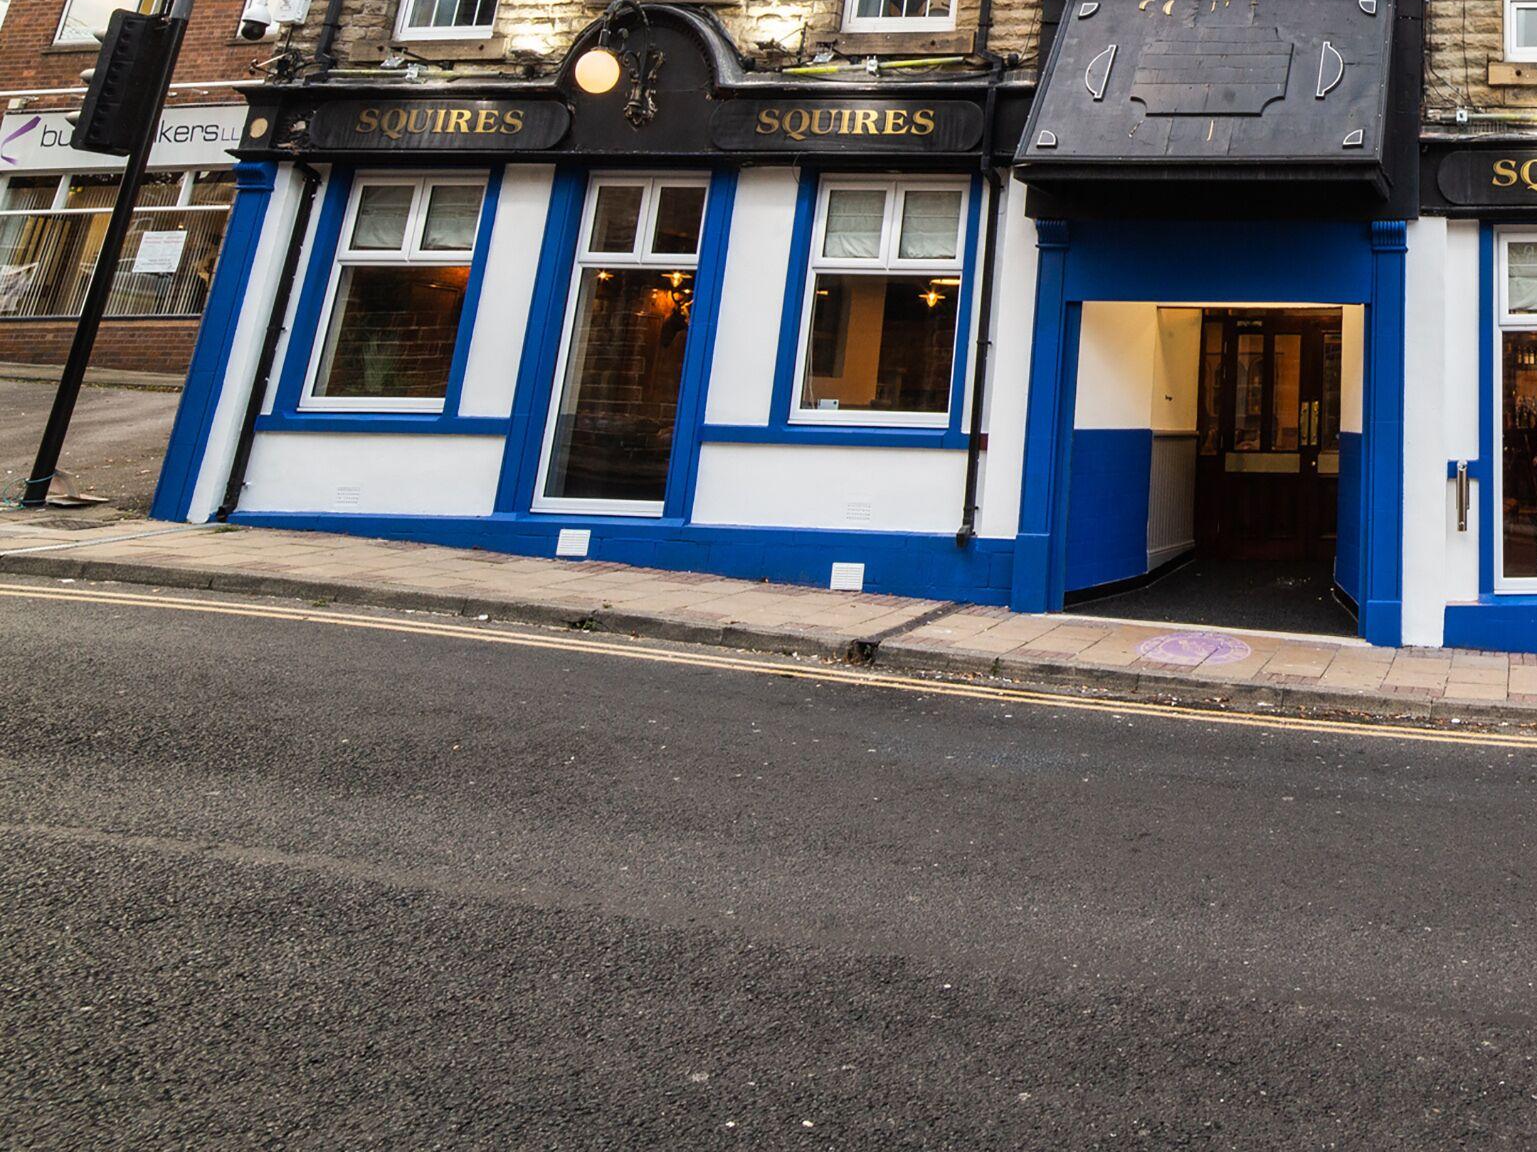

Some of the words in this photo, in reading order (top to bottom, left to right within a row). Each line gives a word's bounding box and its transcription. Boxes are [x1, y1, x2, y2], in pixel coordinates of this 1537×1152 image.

[221, 126, 241, 142] LL
[355, 107, 525, 140] SQUIRES
[755, 108, 936, 141] SQUIRES
